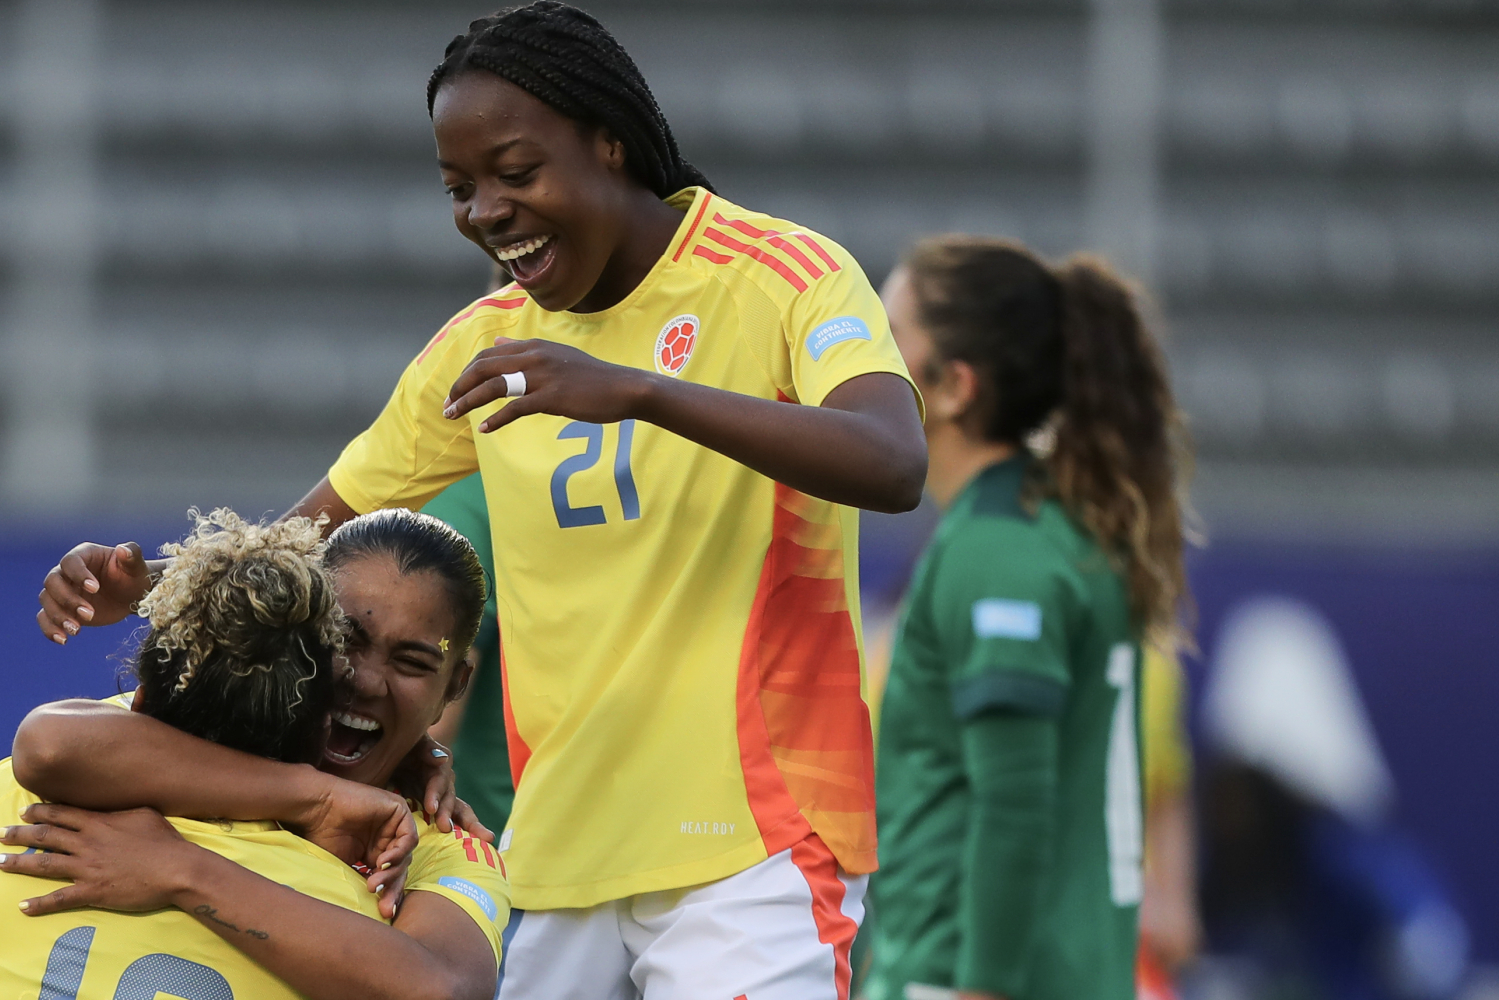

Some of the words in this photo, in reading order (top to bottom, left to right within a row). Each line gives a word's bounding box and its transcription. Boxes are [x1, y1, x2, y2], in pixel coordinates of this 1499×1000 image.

[814, 326, 863, 350] CONTINENTE
[816, 323, 840, 339] VIBRA
[841, 320, 853, 328] EL
[550, 419, 641, 528] 21
[446, 883, 492, 914] CONTINENTE
[455, 881, 479, 896] VIBRA
[480, 893, 489, 904] EL
